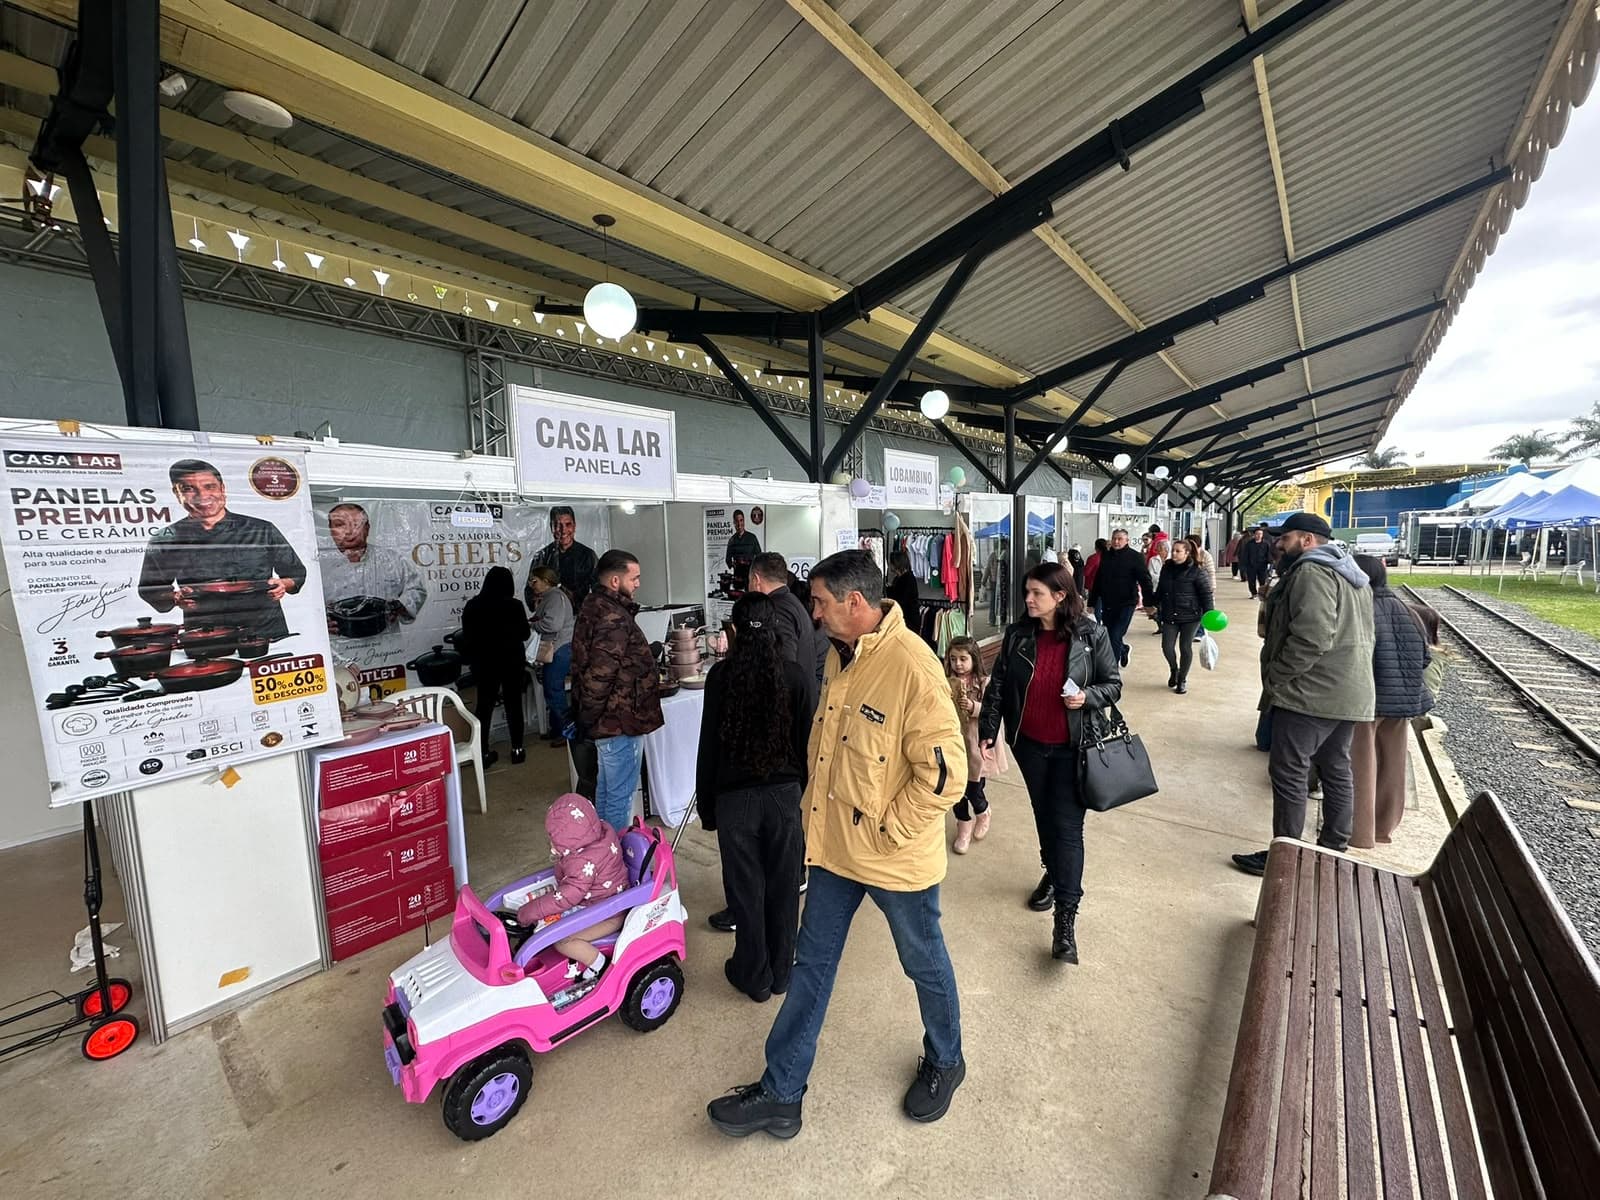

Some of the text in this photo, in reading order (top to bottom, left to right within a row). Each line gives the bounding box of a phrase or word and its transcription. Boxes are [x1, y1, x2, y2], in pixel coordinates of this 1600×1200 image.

[536, 417, 662, 458] CASA LAR
[9, 453, 116, 467] CASA LAR
[565, 457, 641, 476] PANELAS
[271, 474, 279, 484] 3
[889, 466, 933, 485] LOBAMBINO
[10, 487, 157, 505] PANELAS
[894, 486, 929, 495] LOJA INFANTIL
[14, 506, 172, 526] PREMIUM
[707, 521, 731, 529] PANELAS
[18, 525, 175, 541] DE CERÂMICA
[457, 532, 502, 541] MAIORES
[46, 548, 94, 559] qualidade
[411, 540, 522, 567] CHEFS
[24, 557, 107, 569] para sua cozinha
[428, 569, 448, 581] DE
[791, 562, 810, 580] 26
[36, 575, 80, 583] CONJUNTO
[440, 582, 460, 592] DO
[53, 640, 69, 655] 3
[48, 659, 80, 667] GARANTIA
[258, 658, 316, 675] OUTLET
[254, 677, 287, 694] 50%
[294, 671, 324, 687] 60%
[258, 684, 323, 702] DE DESCONTO
[103, 695, 193, 715] Qualidade Comprovada
[211, 742, 244, 756] BSCI
[404, 750, 417, 760] 20
[143, 762, 159, 770] ISO
[400, 802, 413, 812] 20
[401, 848, 414, 859] 20
[408, 894, 421, 904] 20
